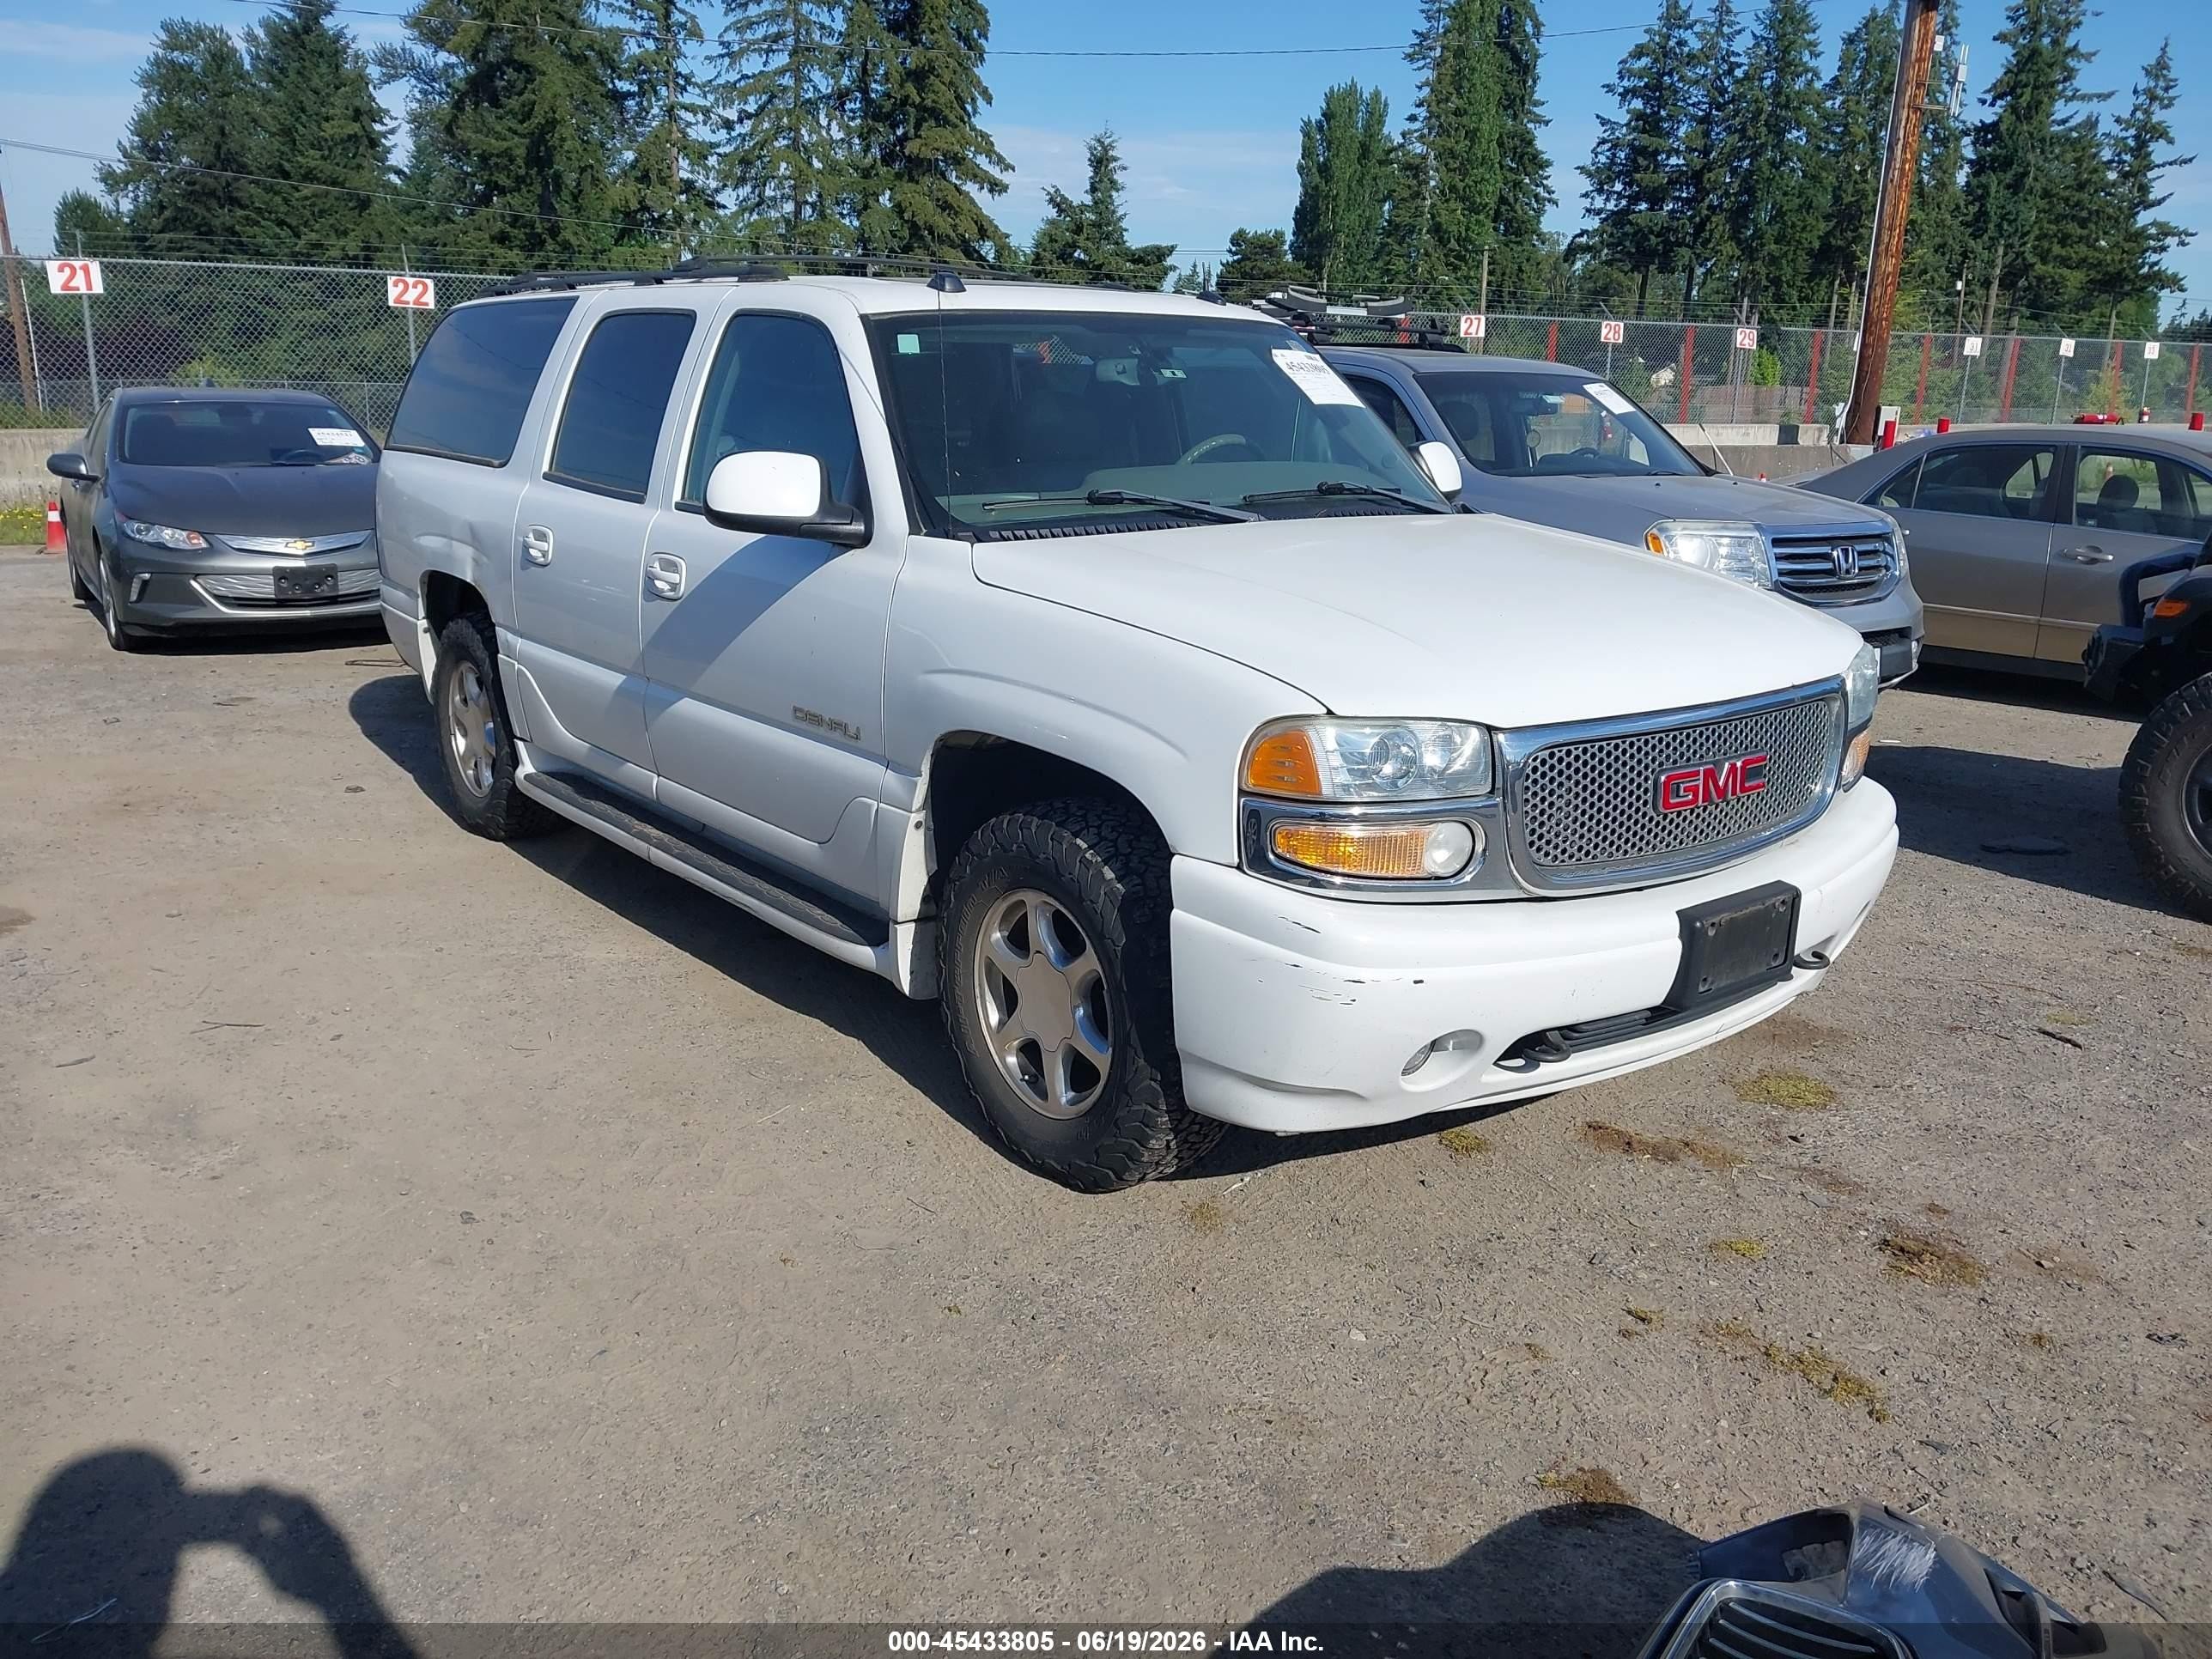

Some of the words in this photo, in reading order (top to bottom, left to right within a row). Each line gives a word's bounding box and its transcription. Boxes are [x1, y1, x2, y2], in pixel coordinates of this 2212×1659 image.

[57, 262, 94, 292] 21
[392, 278, 429, 307] 22
[1463, 316, 1482, 337] 27
[1602, 322, 1621, 342] 28
[1739, 329, 1755, 348] 29
[792, 704, 861, 741] DENALI
[1661, 752, 1768, 813] GMC
